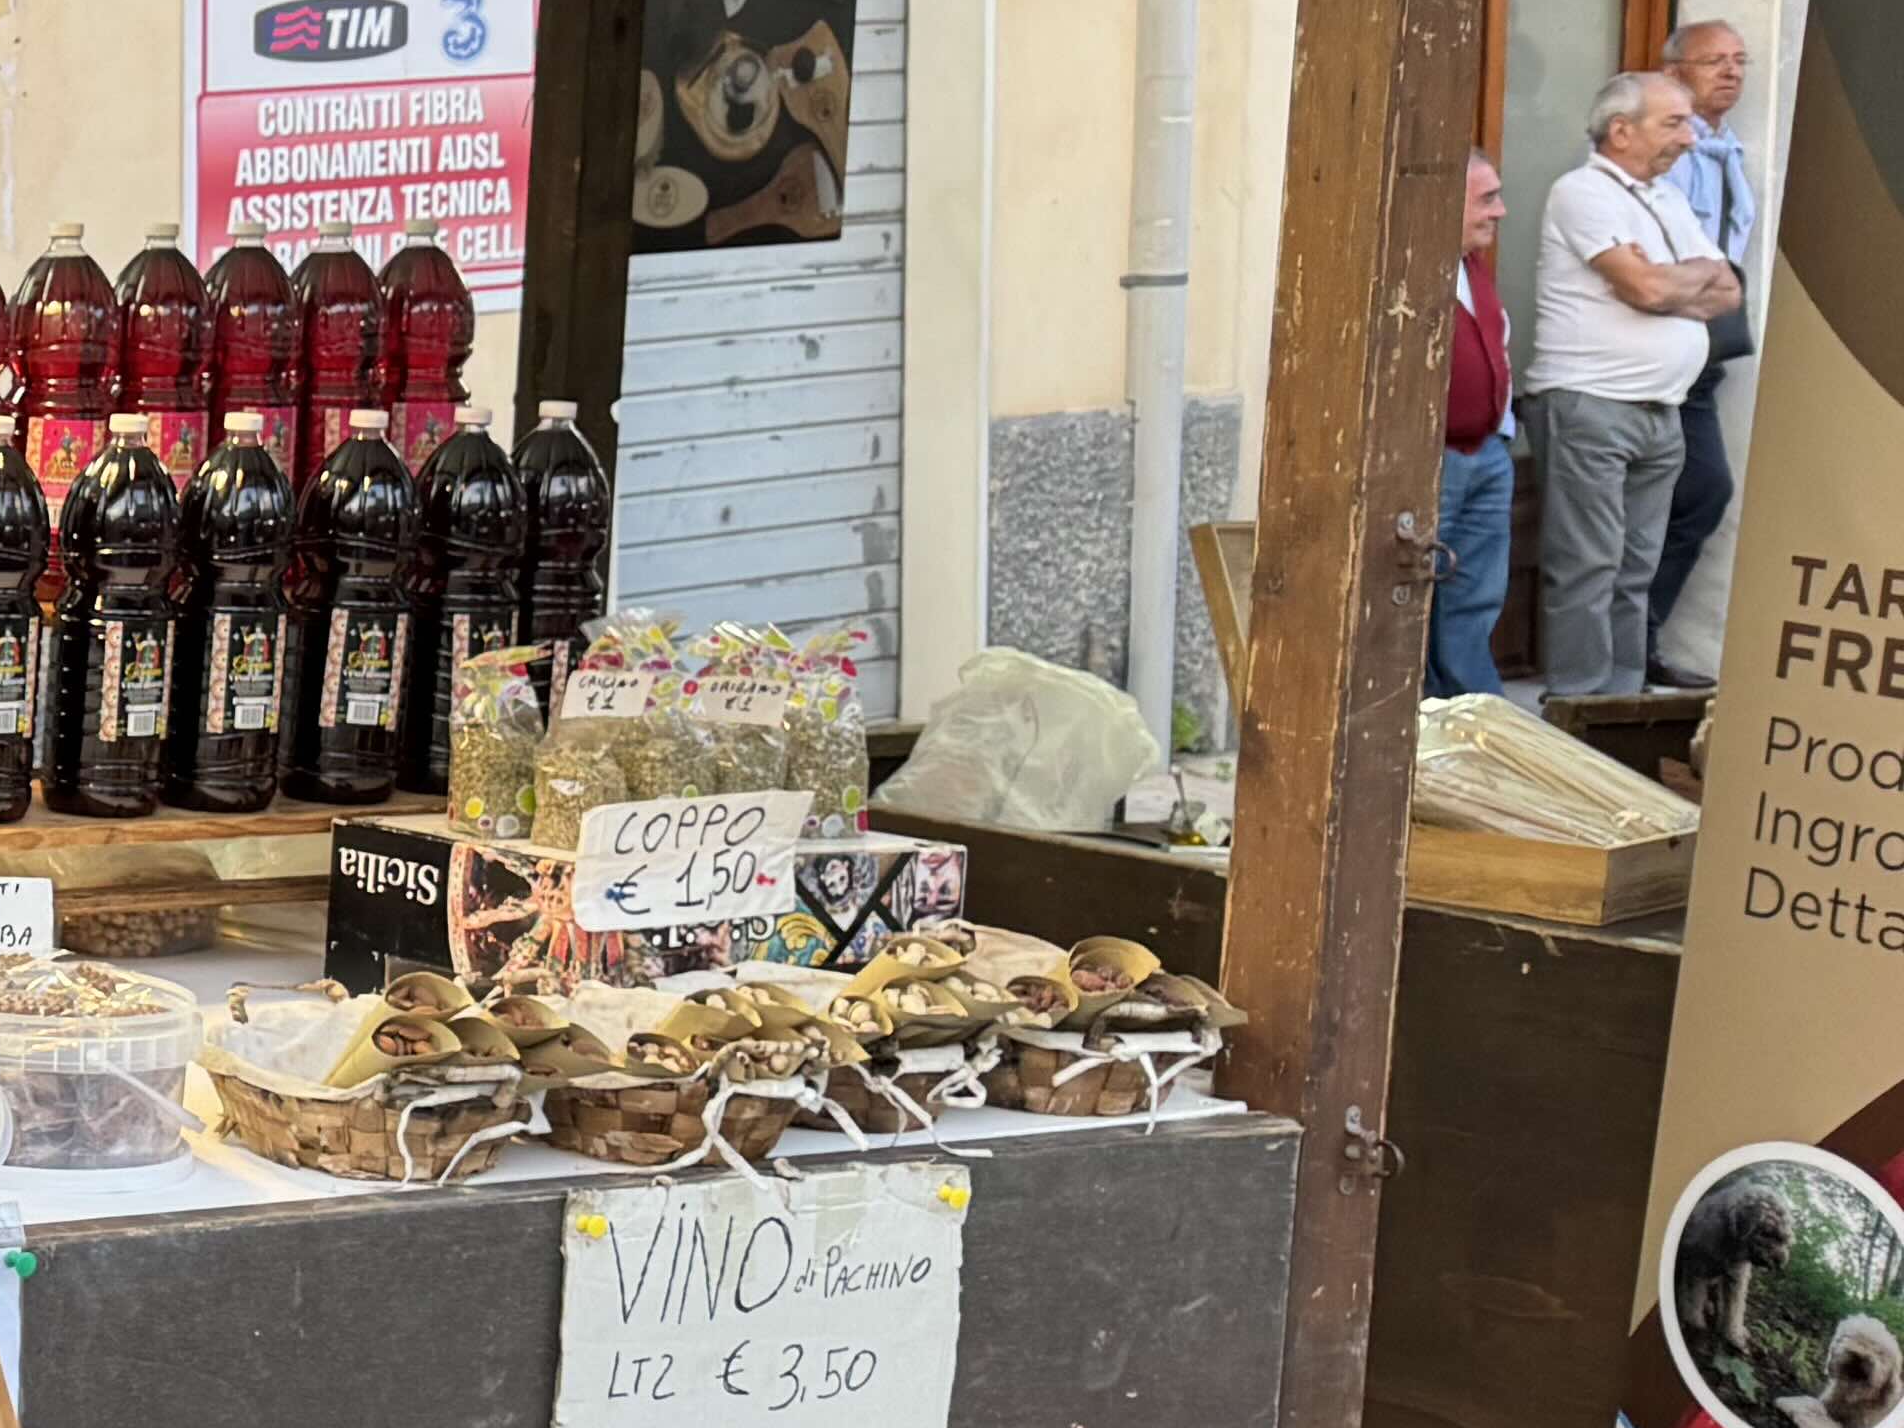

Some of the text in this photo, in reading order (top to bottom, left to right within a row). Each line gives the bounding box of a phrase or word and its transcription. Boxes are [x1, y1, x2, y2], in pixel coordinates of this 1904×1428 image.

[326, 6, 396, 50] TIM
[257, 87, 485, 138] CONTRATTI FIBRA
[235, 132, 506, 187] ABBONAMENTI ADSL
[226, 177, 512, 235] ASSISTENZA TECNICA
[456, 223, 525, 263] CELL.
[613, 803, 766, 856] COPPO
[338, 845, 441, 906] Sicilia
[611, 848, 758, 915] € 1,50
[715, 1339, 751, 1396] €
[767, 1342, 878, 1411] 3,50
